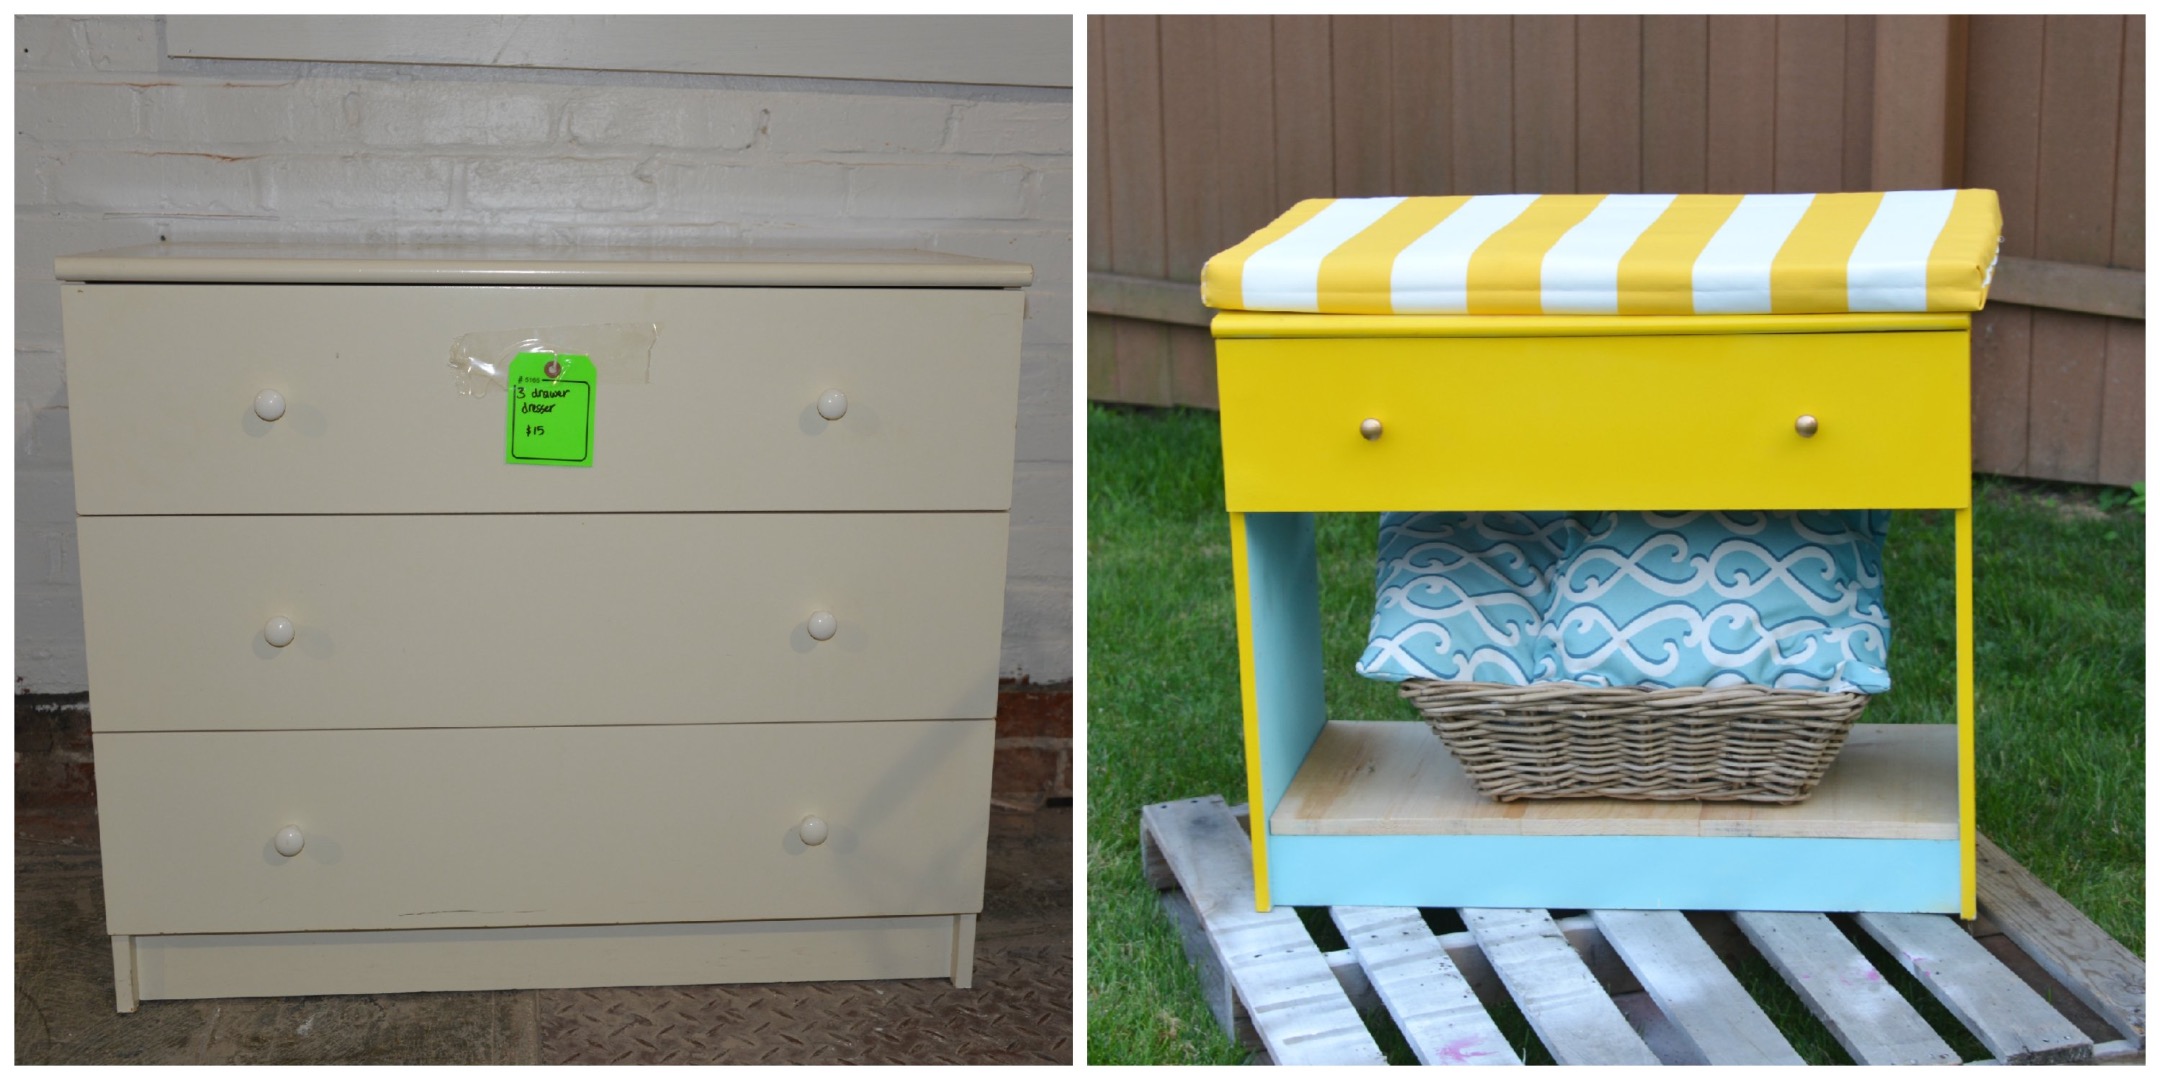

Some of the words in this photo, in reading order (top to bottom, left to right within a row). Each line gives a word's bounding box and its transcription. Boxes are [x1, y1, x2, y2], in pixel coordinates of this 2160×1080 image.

[516, 387, 526, 399] 3
[531, 388, 570, 398] drawer
[521, 402, 556, 414] dresser
[526, 424, 545, 437] $15
